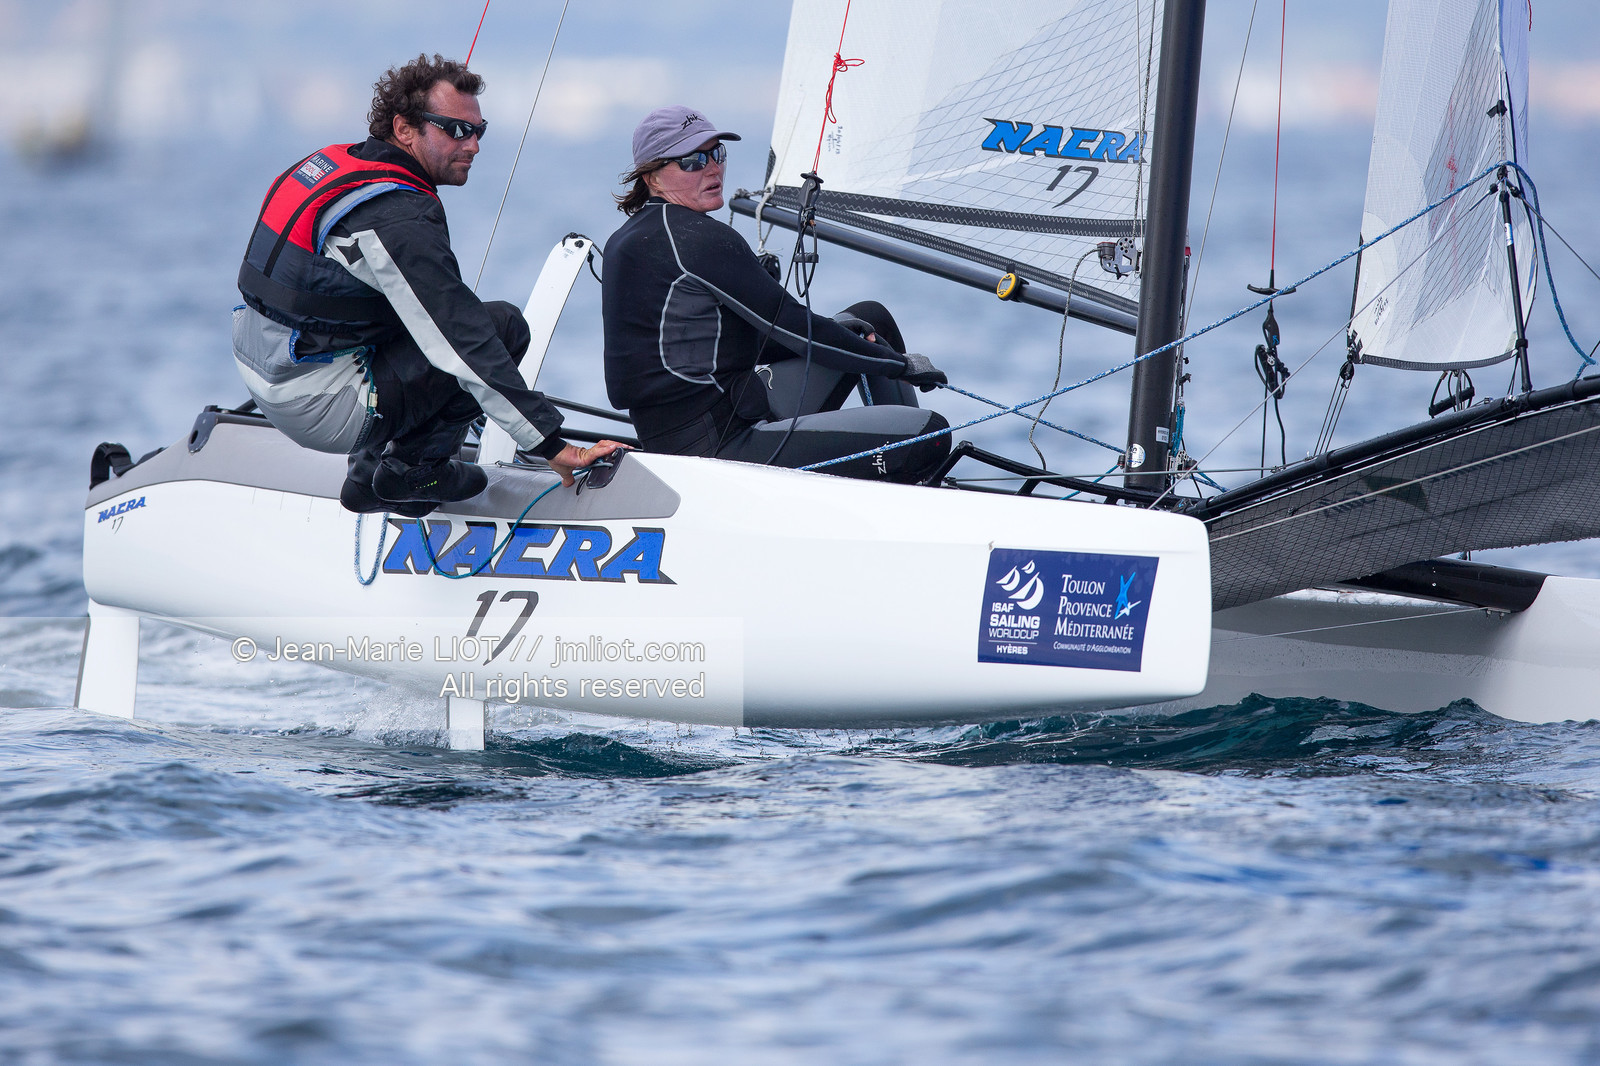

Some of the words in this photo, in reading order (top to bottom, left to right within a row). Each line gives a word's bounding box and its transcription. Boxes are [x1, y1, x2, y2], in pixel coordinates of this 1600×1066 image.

[982, 117, 1147, 163] NACRA
[311, 154, 334, 173] MARINE
[1046, 165, 1099, 209] 17
[98, 496, 147, 523] NACRA
[112, 515, 124, 534] 17
[382, 518, 677, 585] NACRA
[992, 602, 1014, 613] ISAF
[466, 590, 539, 666] 17
[990, 614, 1040, 629] SAILING
[988, 628, 1039, 640] WORLDCUP
[996, 643, 1028, 655] HYÈRES
